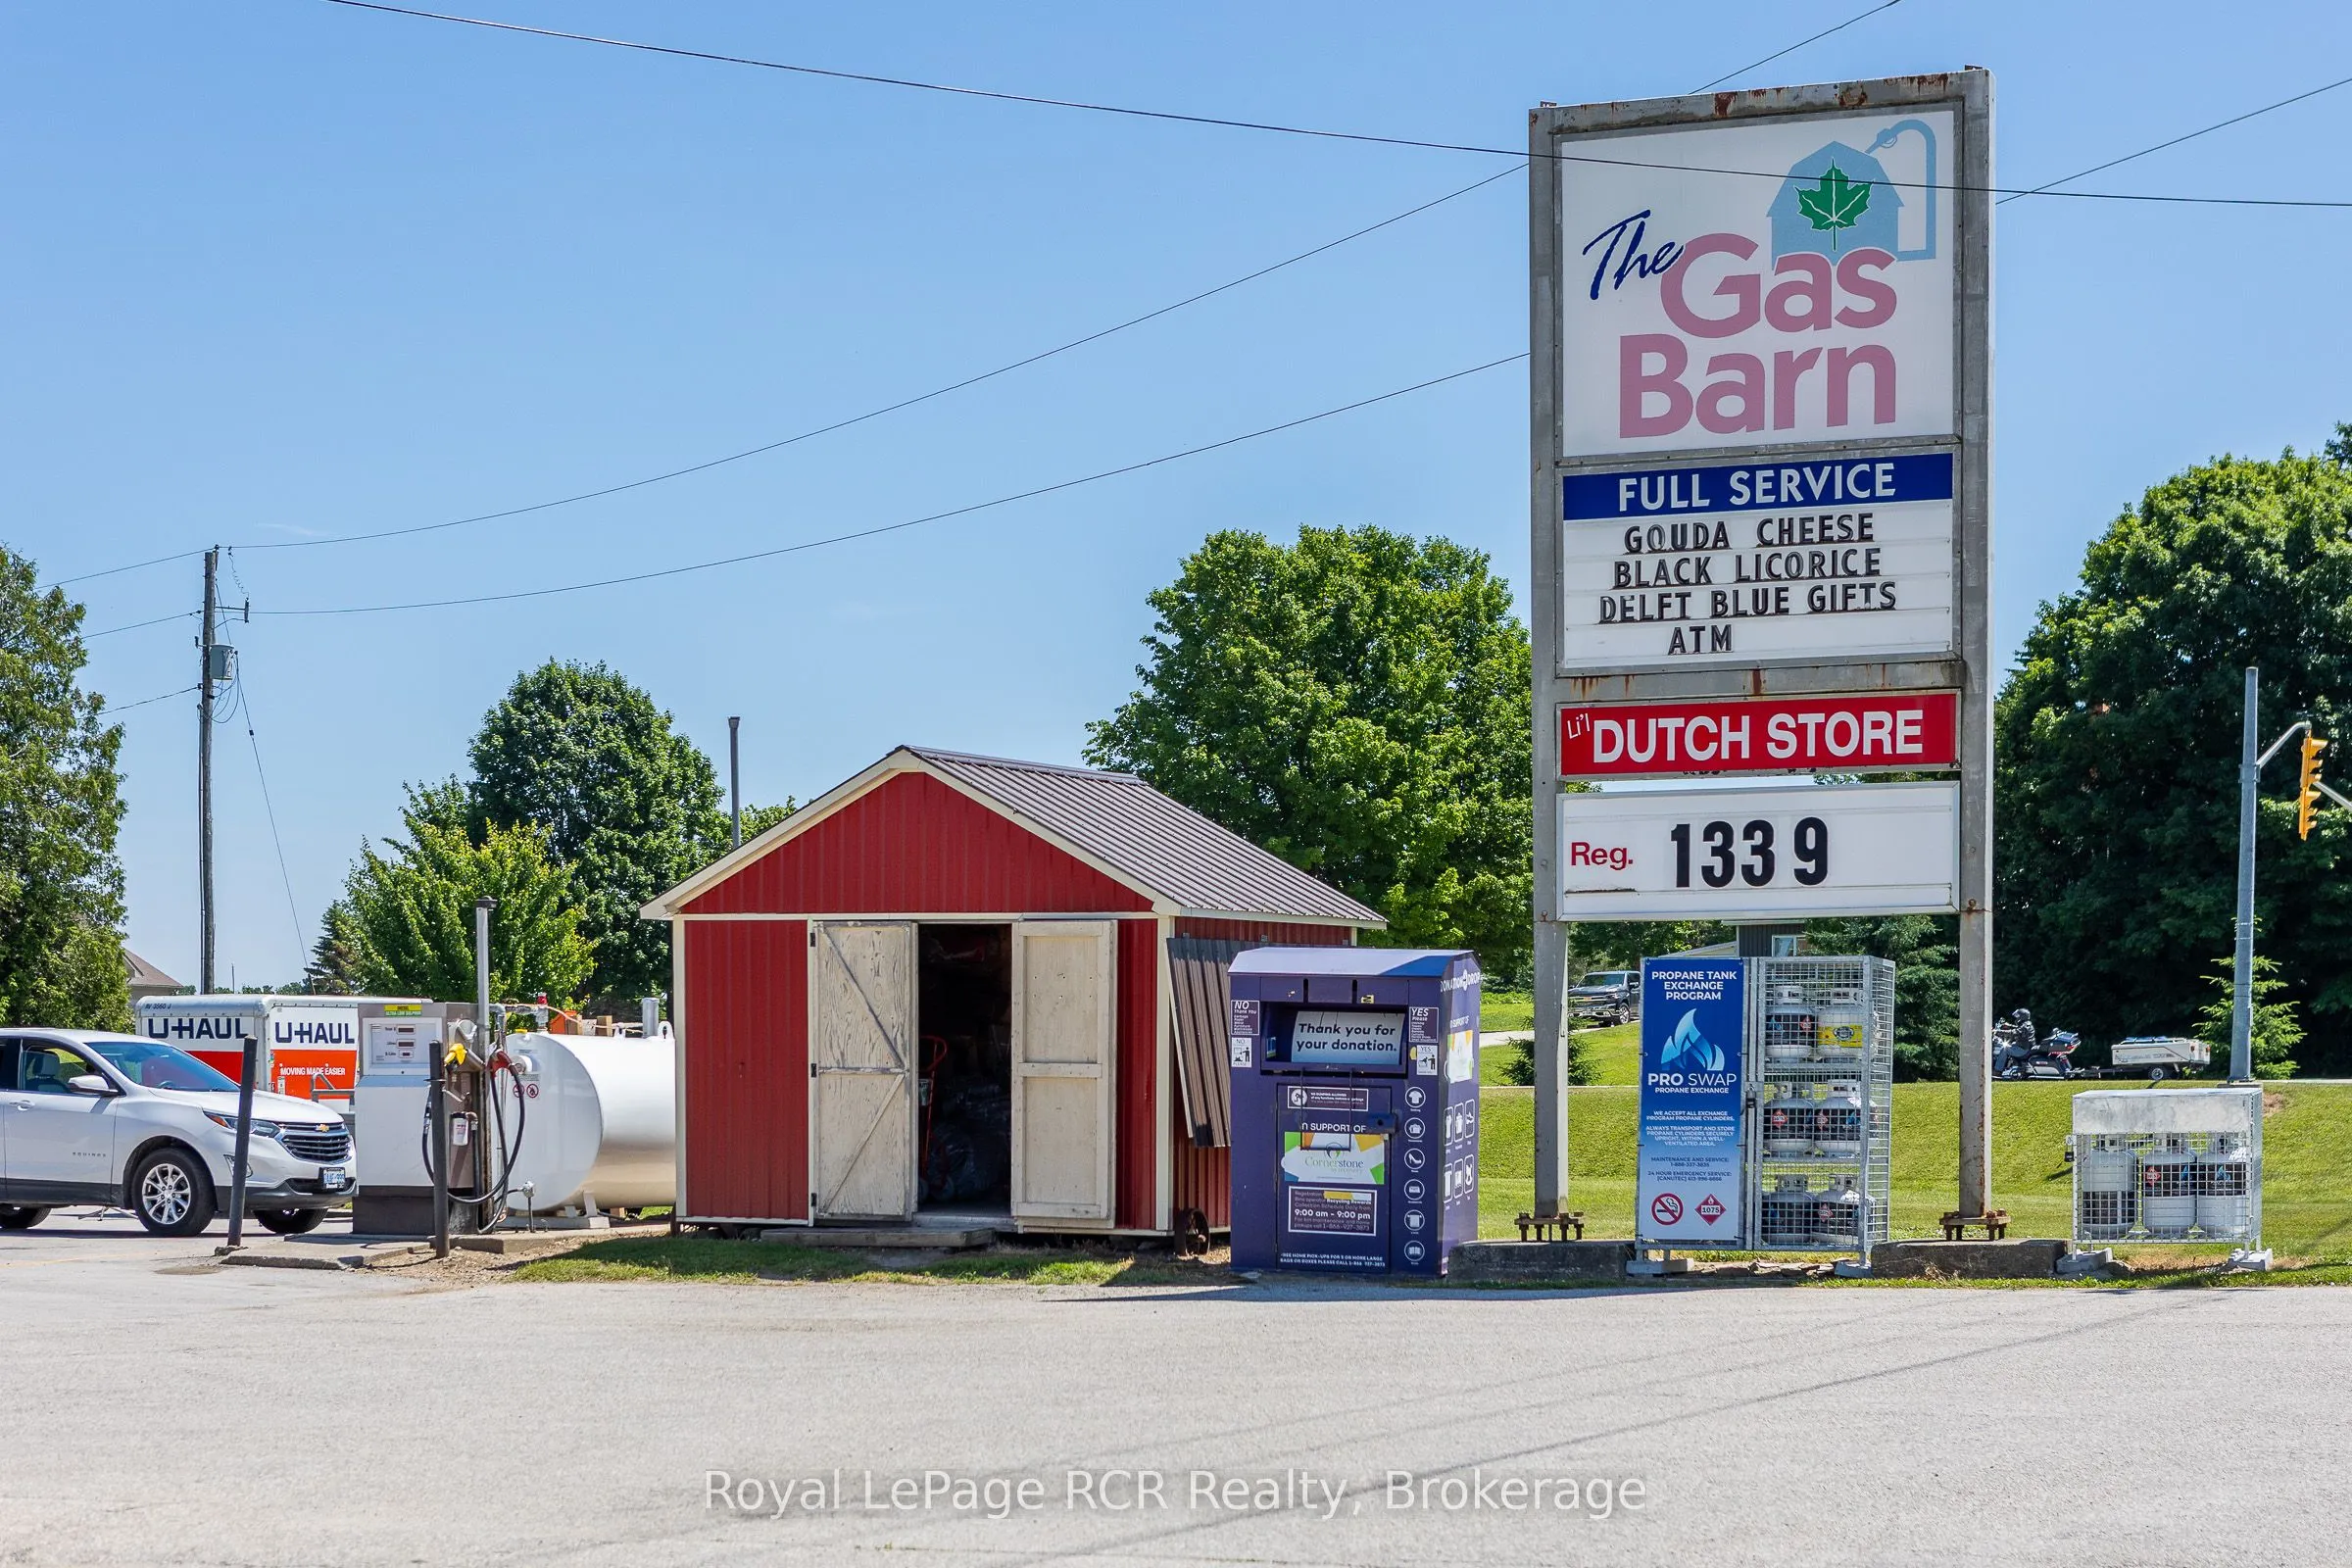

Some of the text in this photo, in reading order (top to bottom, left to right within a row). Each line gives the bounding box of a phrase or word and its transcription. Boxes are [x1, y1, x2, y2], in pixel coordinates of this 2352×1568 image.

[1583, 209, 1685, 300] The
[1660, 233, 1897, 338] Gas
[1619, 333, 1896, 438] Barn
[1619, 463, 1896, 512] FULL SERVICE
[1624, 513, 1875, 555] GOUDA CHEESE
[1613, 547, 1882, 589] BLACK LICORICE
[1598, 581, 1897, 623] DELFT BLUE GIFTS
[1668, 624, 1733, 655] ATM
[1593, 715, 1750, 763] DUTCH
[1766, 710, 1924, 759] STORE
[1570, 841, 1634, 870] Reg.
[1651, 971, 1738, 980] PROPANE TANK
[1663, 981, 1724, 990] EXCHANGE
[1234, 1001, 1250, 1009] NO
[1665, 991, 1722, 1001] PROGRAM
[1411, 1007, 1429, 1016] YES
[148, 1017, 249, 1040] U-HAUL
[275, 1022, 356, 1044] U-HAUL
[1298, 1023, 1396, 1037] Thank you for
[1297, 1039, 1397, 1052] your donation.
[324, 1067, 346, 1076] EASIER
[1647, 1073, 1738, 1086] PRO SWAP
[1310, 1123, 1350, 1132] SUPPORT
[1304, 1156, 1364, 1168] Cornerstone
